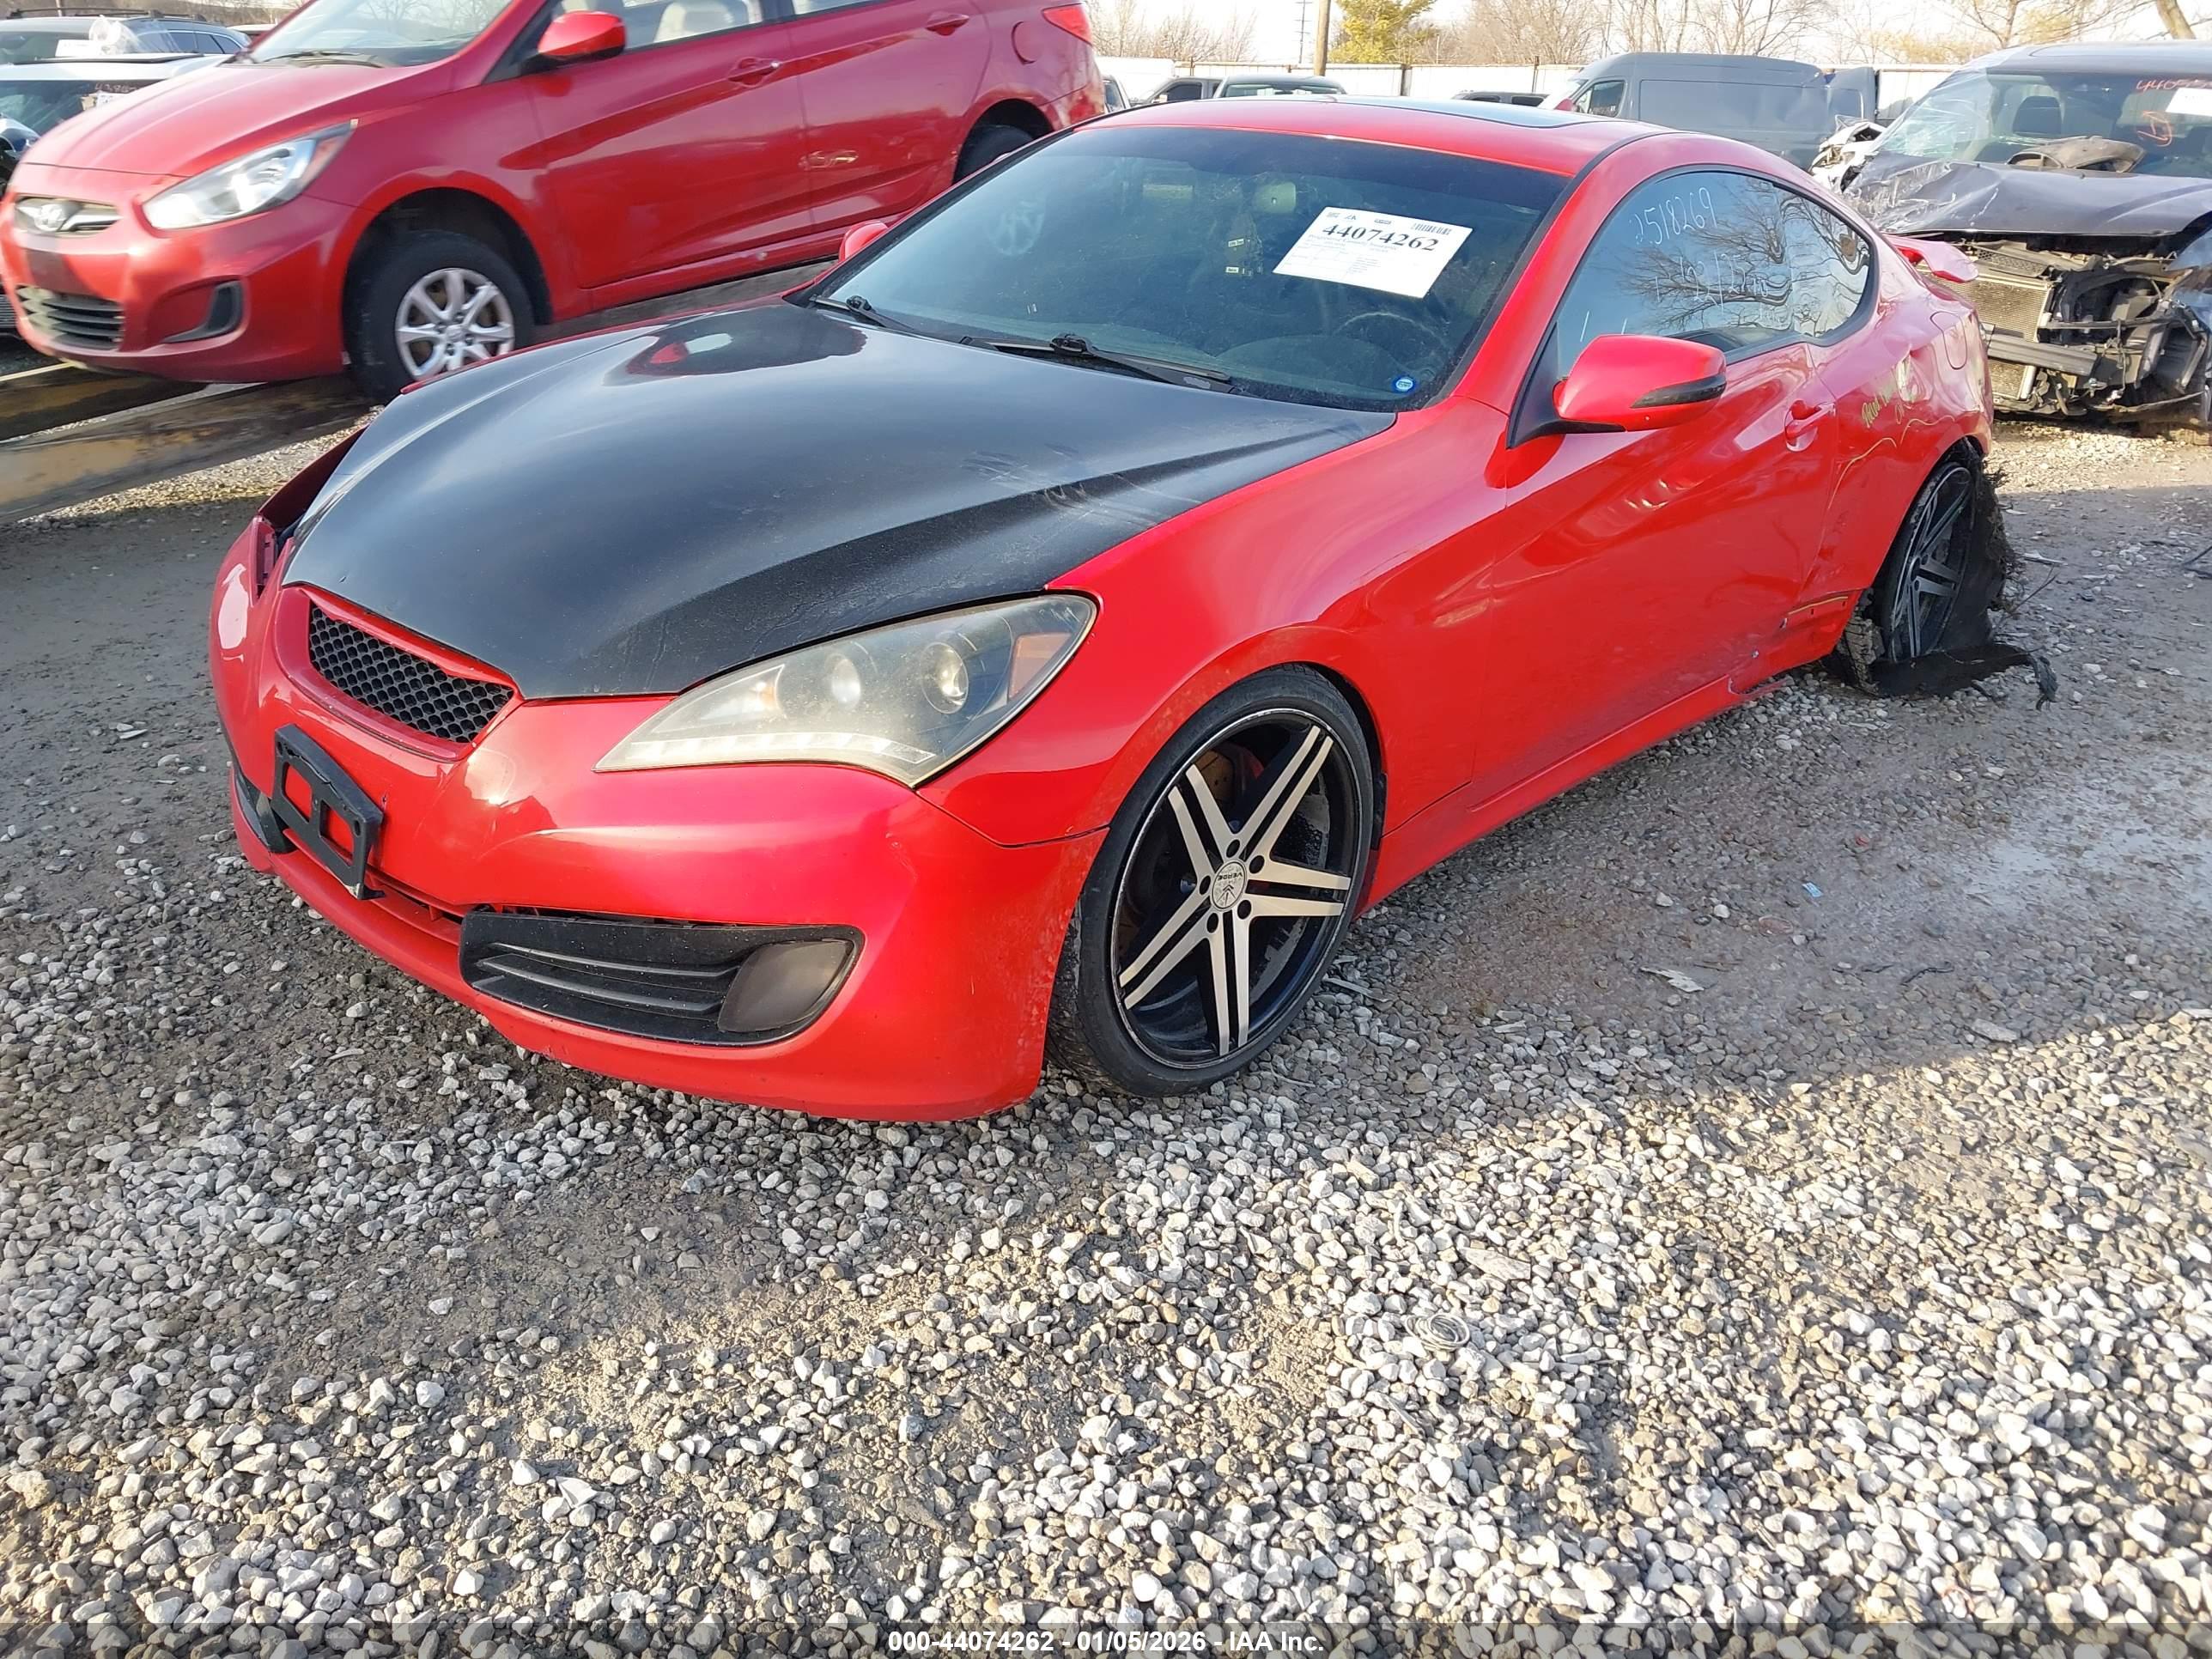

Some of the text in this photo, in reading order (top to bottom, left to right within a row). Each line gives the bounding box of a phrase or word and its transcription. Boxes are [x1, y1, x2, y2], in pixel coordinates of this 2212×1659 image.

[1629, 187, 1717, 245] 2518269
[1322, 224, 1439, 251] 44074262
[1217, 872, 1243, 881] VERDE
